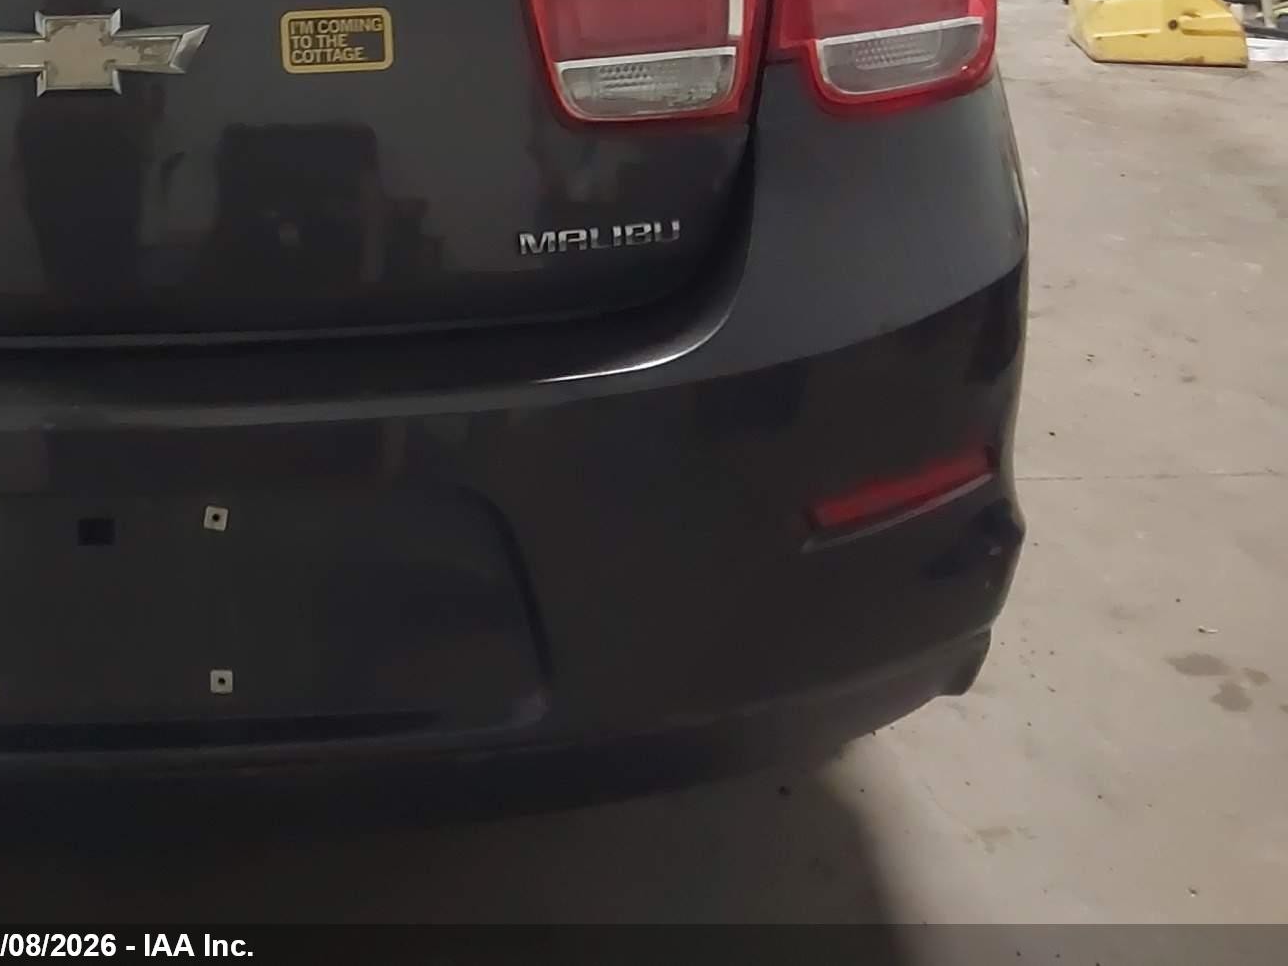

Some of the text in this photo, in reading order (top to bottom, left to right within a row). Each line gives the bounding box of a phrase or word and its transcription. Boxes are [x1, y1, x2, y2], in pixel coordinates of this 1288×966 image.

[291, 17, 384, 35] I'M COMING
[291, 34, 349, 49] TO THE
[519, 220, 681, 255] MALIBU
